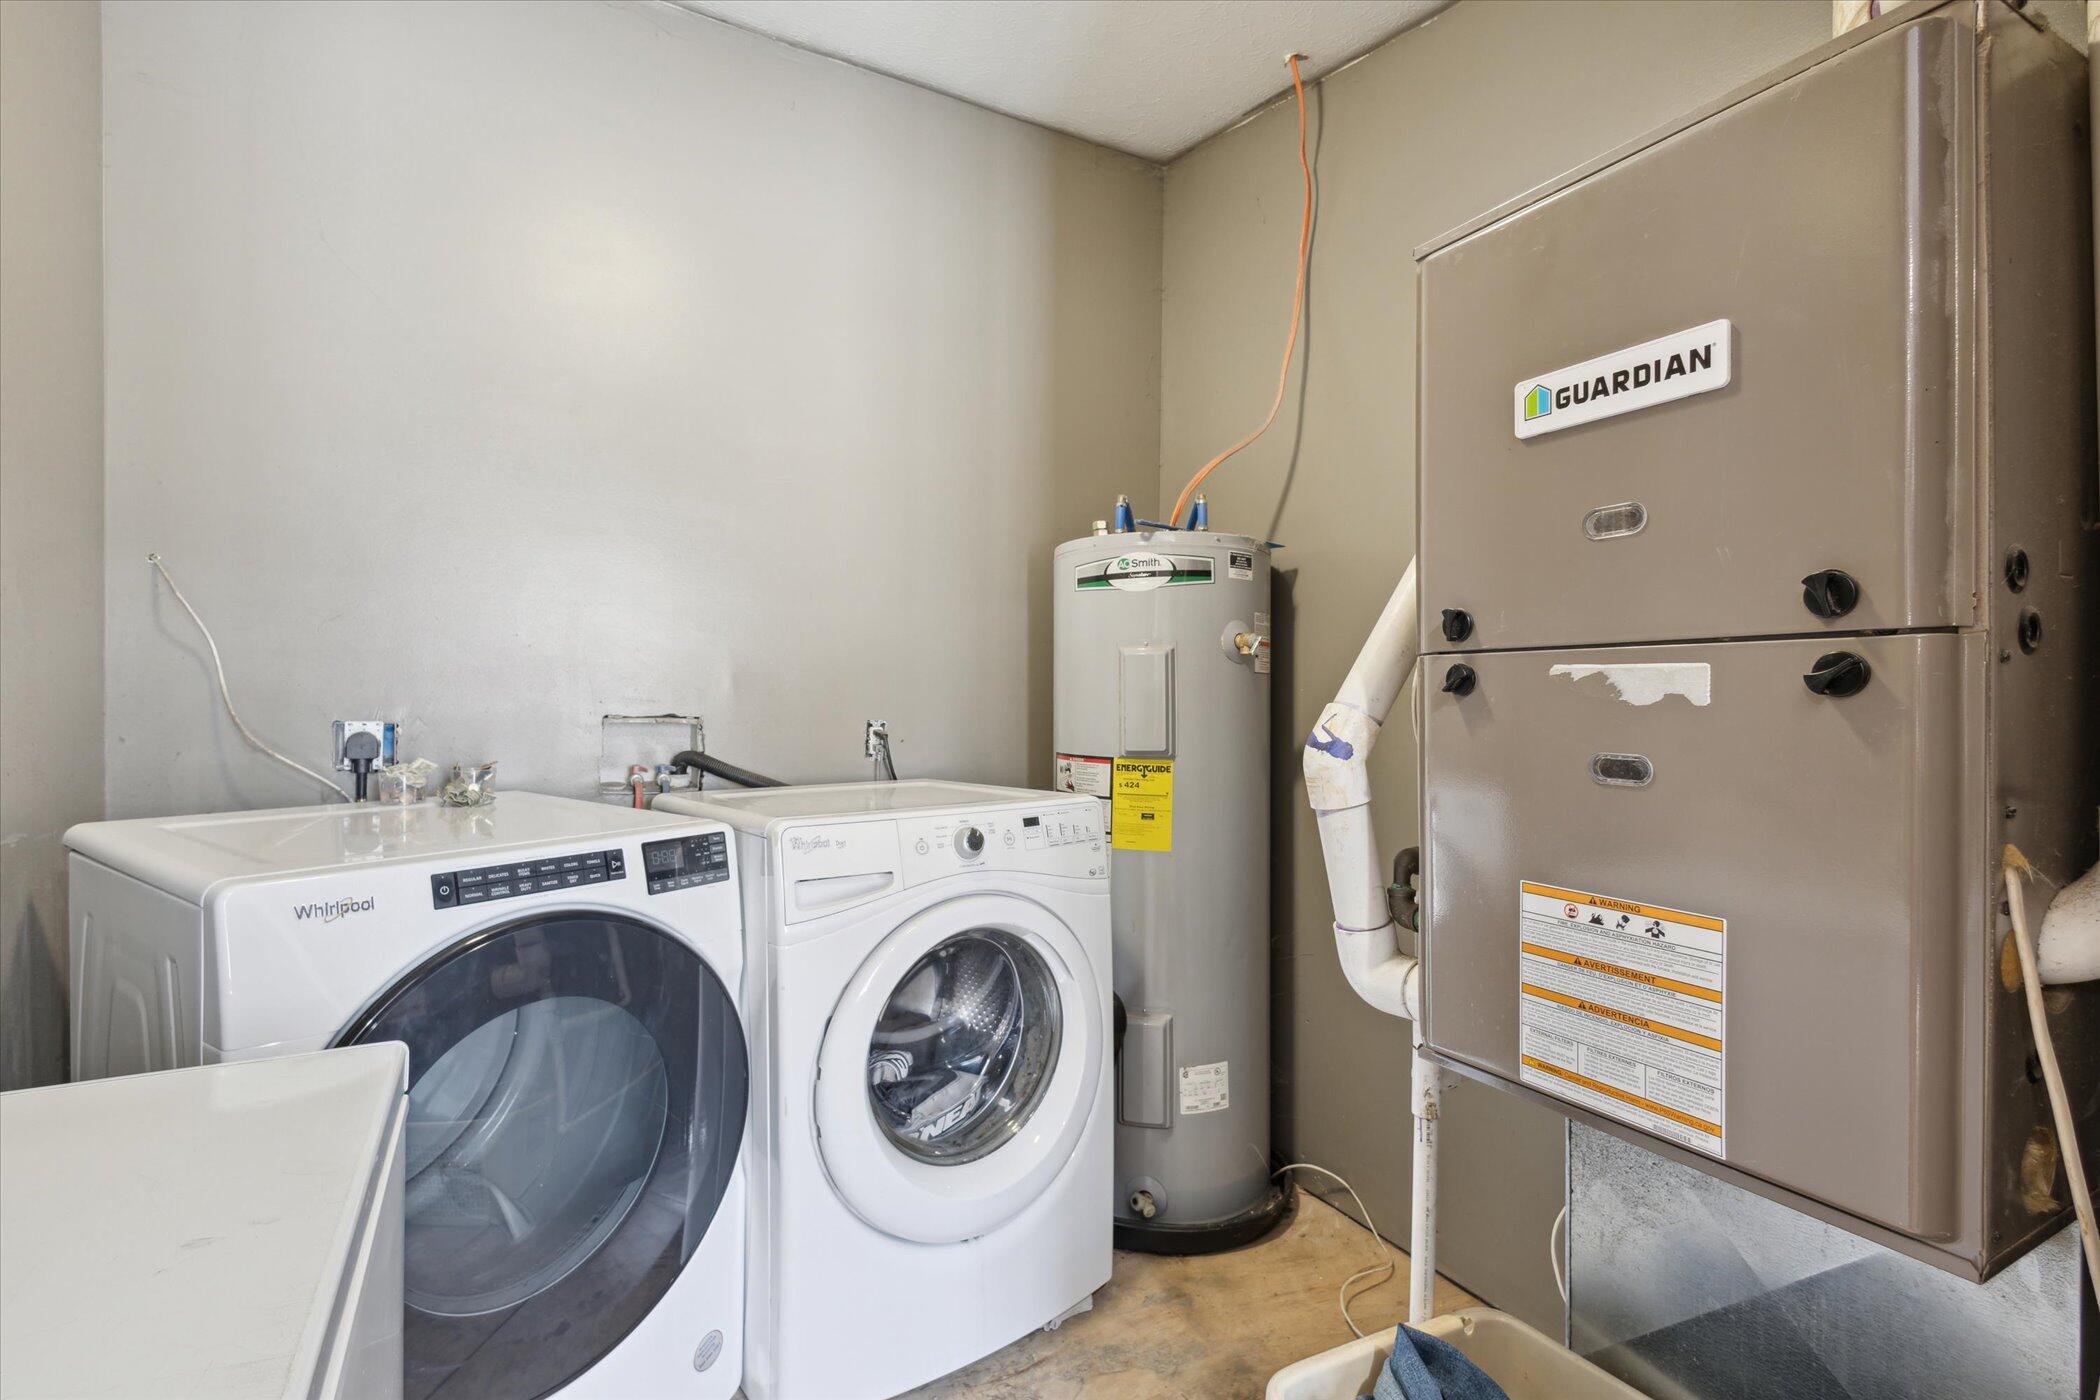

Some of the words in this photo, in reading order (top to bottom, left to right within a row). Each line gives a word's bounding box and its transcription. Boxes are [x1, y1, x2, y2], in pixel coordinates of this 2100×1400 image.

[1555, 344, 1711, 409] GUARDIAN
[1131, 558, 1160, 568] Smith
[1116, 764, 1171, 776] ENERGYGUIDE
[293, 897, 375, 920] Whirlpool
[1599, 899, 1641, 914] WARNING
[1584, 960, 1656, 984] AVERTISSEMENT
[1589, 1004, 1650, 1028] ADVERTENCIA
